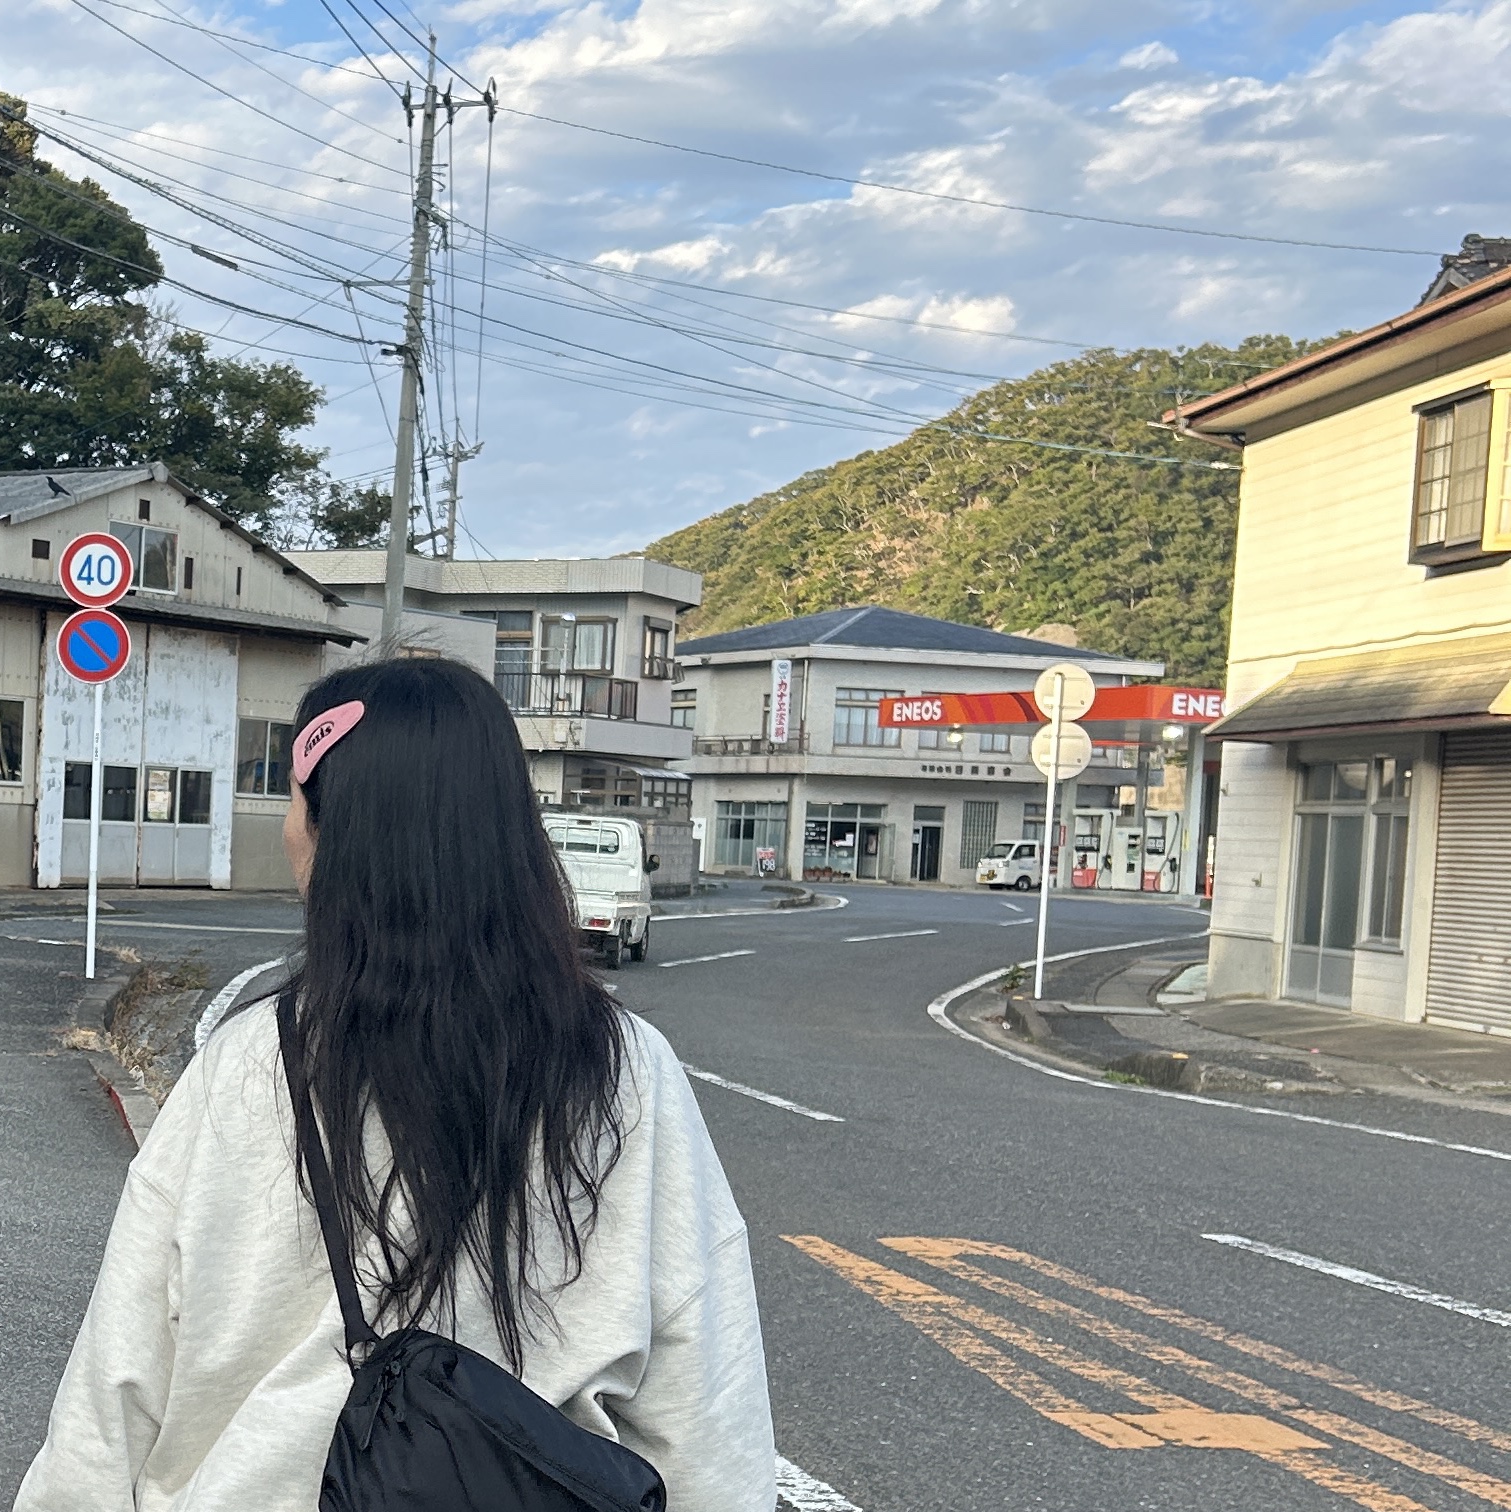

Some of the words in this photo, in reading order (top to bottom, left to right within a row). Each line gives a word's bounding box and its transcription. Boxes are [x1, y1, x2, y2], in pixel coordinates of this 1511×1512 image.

[77, 554, 116, 586] 40
[892, 700, 942, 722] ENEOS
[1172, 692, 1228, 718] ENE
